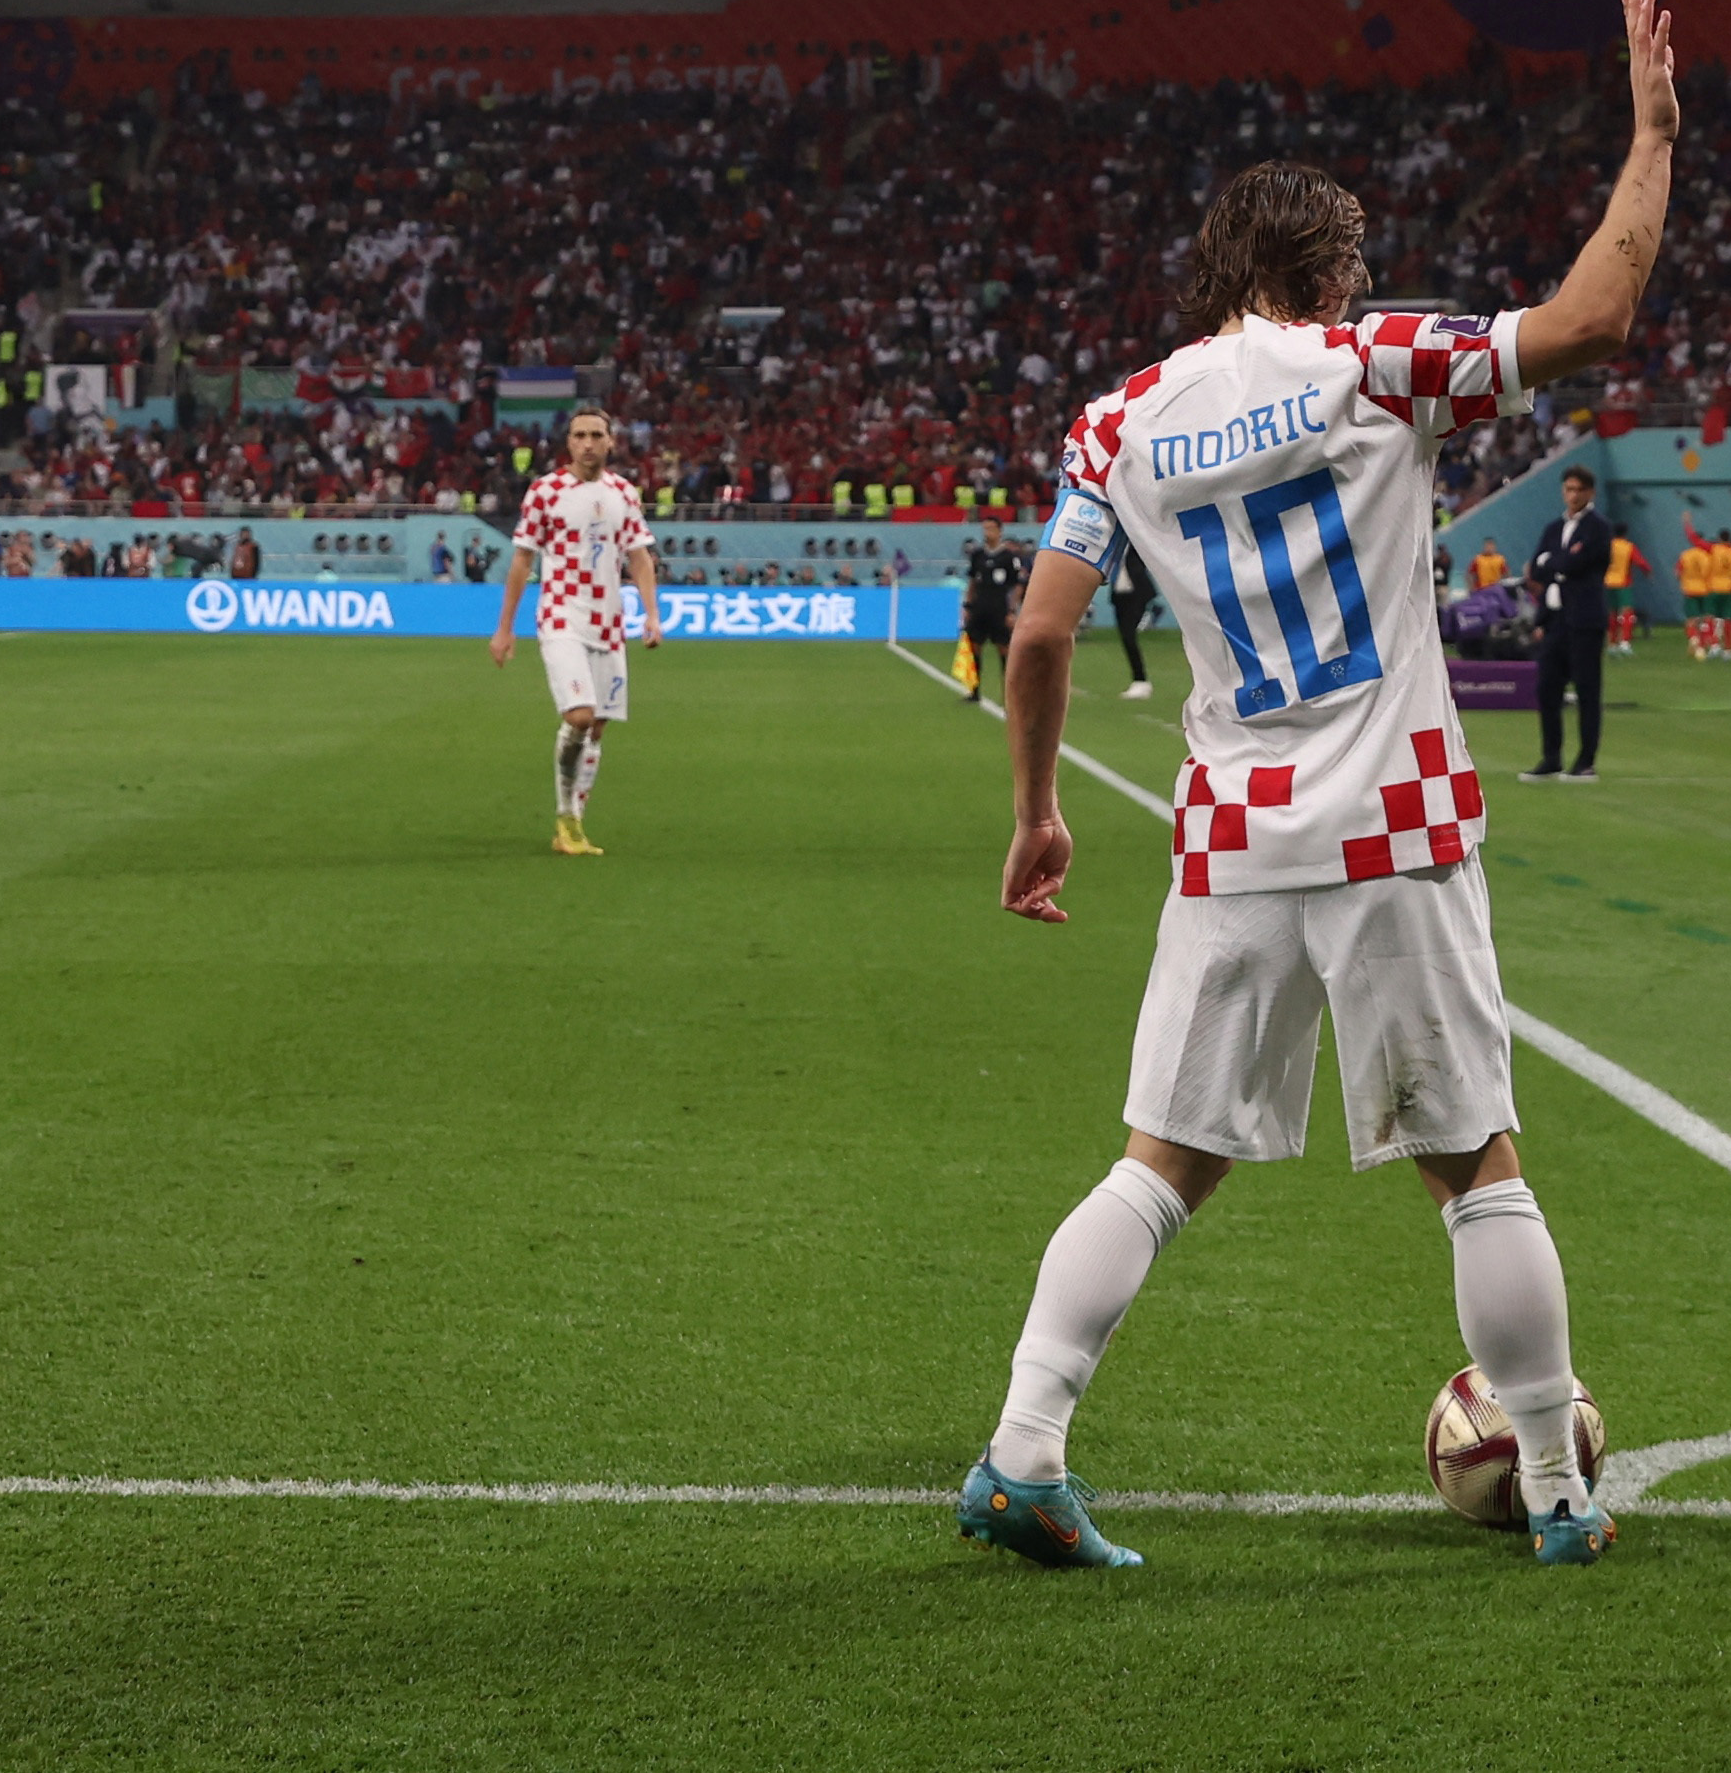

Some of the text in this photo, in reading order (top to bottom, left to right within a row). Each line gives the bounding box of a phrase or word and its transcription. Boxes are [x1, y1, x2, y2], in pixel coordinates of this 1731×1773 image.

[1151, 382, 1326, 480] MODRIĆ
[592, 543, 604, 569] 7
[1067, 541, 1084, 552] FIFA
[242, 589, 395, 630] WANDA
[660, 591, 856, 636] 万达文旅
[1177, 468, 1383, 719] 10
[609, 676, 625, 702] 7
